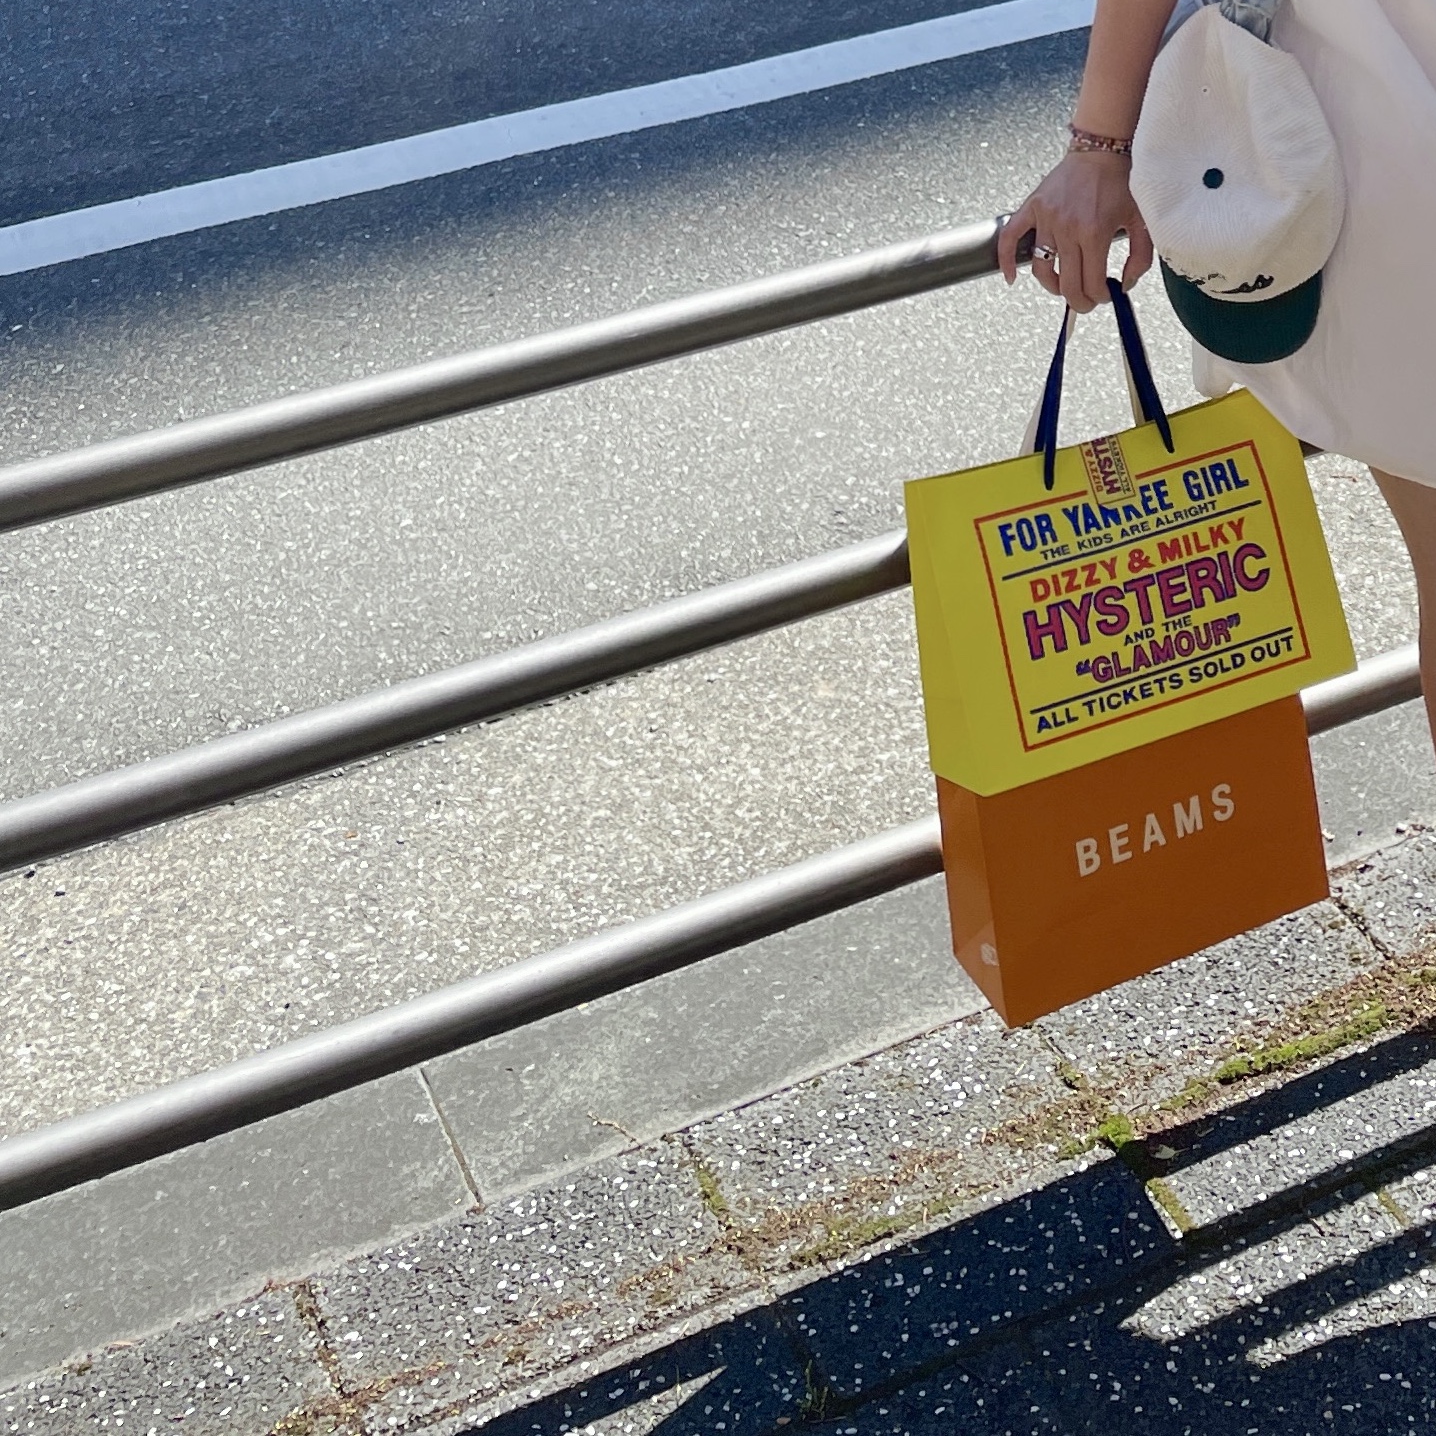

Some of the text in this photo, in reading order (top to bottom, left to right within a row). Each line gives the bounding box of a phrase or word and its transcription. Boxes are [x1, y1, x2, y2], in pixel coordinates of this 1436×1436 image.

[998, 512, 1058, 557] FOR
[1182, 458, 1250, 503] GIRL
[1040, 500, 1218, 561] THE KIDS ARE ALRIGHT
[1022, 542, 1271, 661] HYSTERIC
[1029, 517, 1247, 604] DIZZY & MILKY
[1123, 614, 1193, 647] AND THE
[1036, 634, 1295, 733] ALL TICKETS SOLD OUT
[1075, 783, 1235, 877] BEAMS
